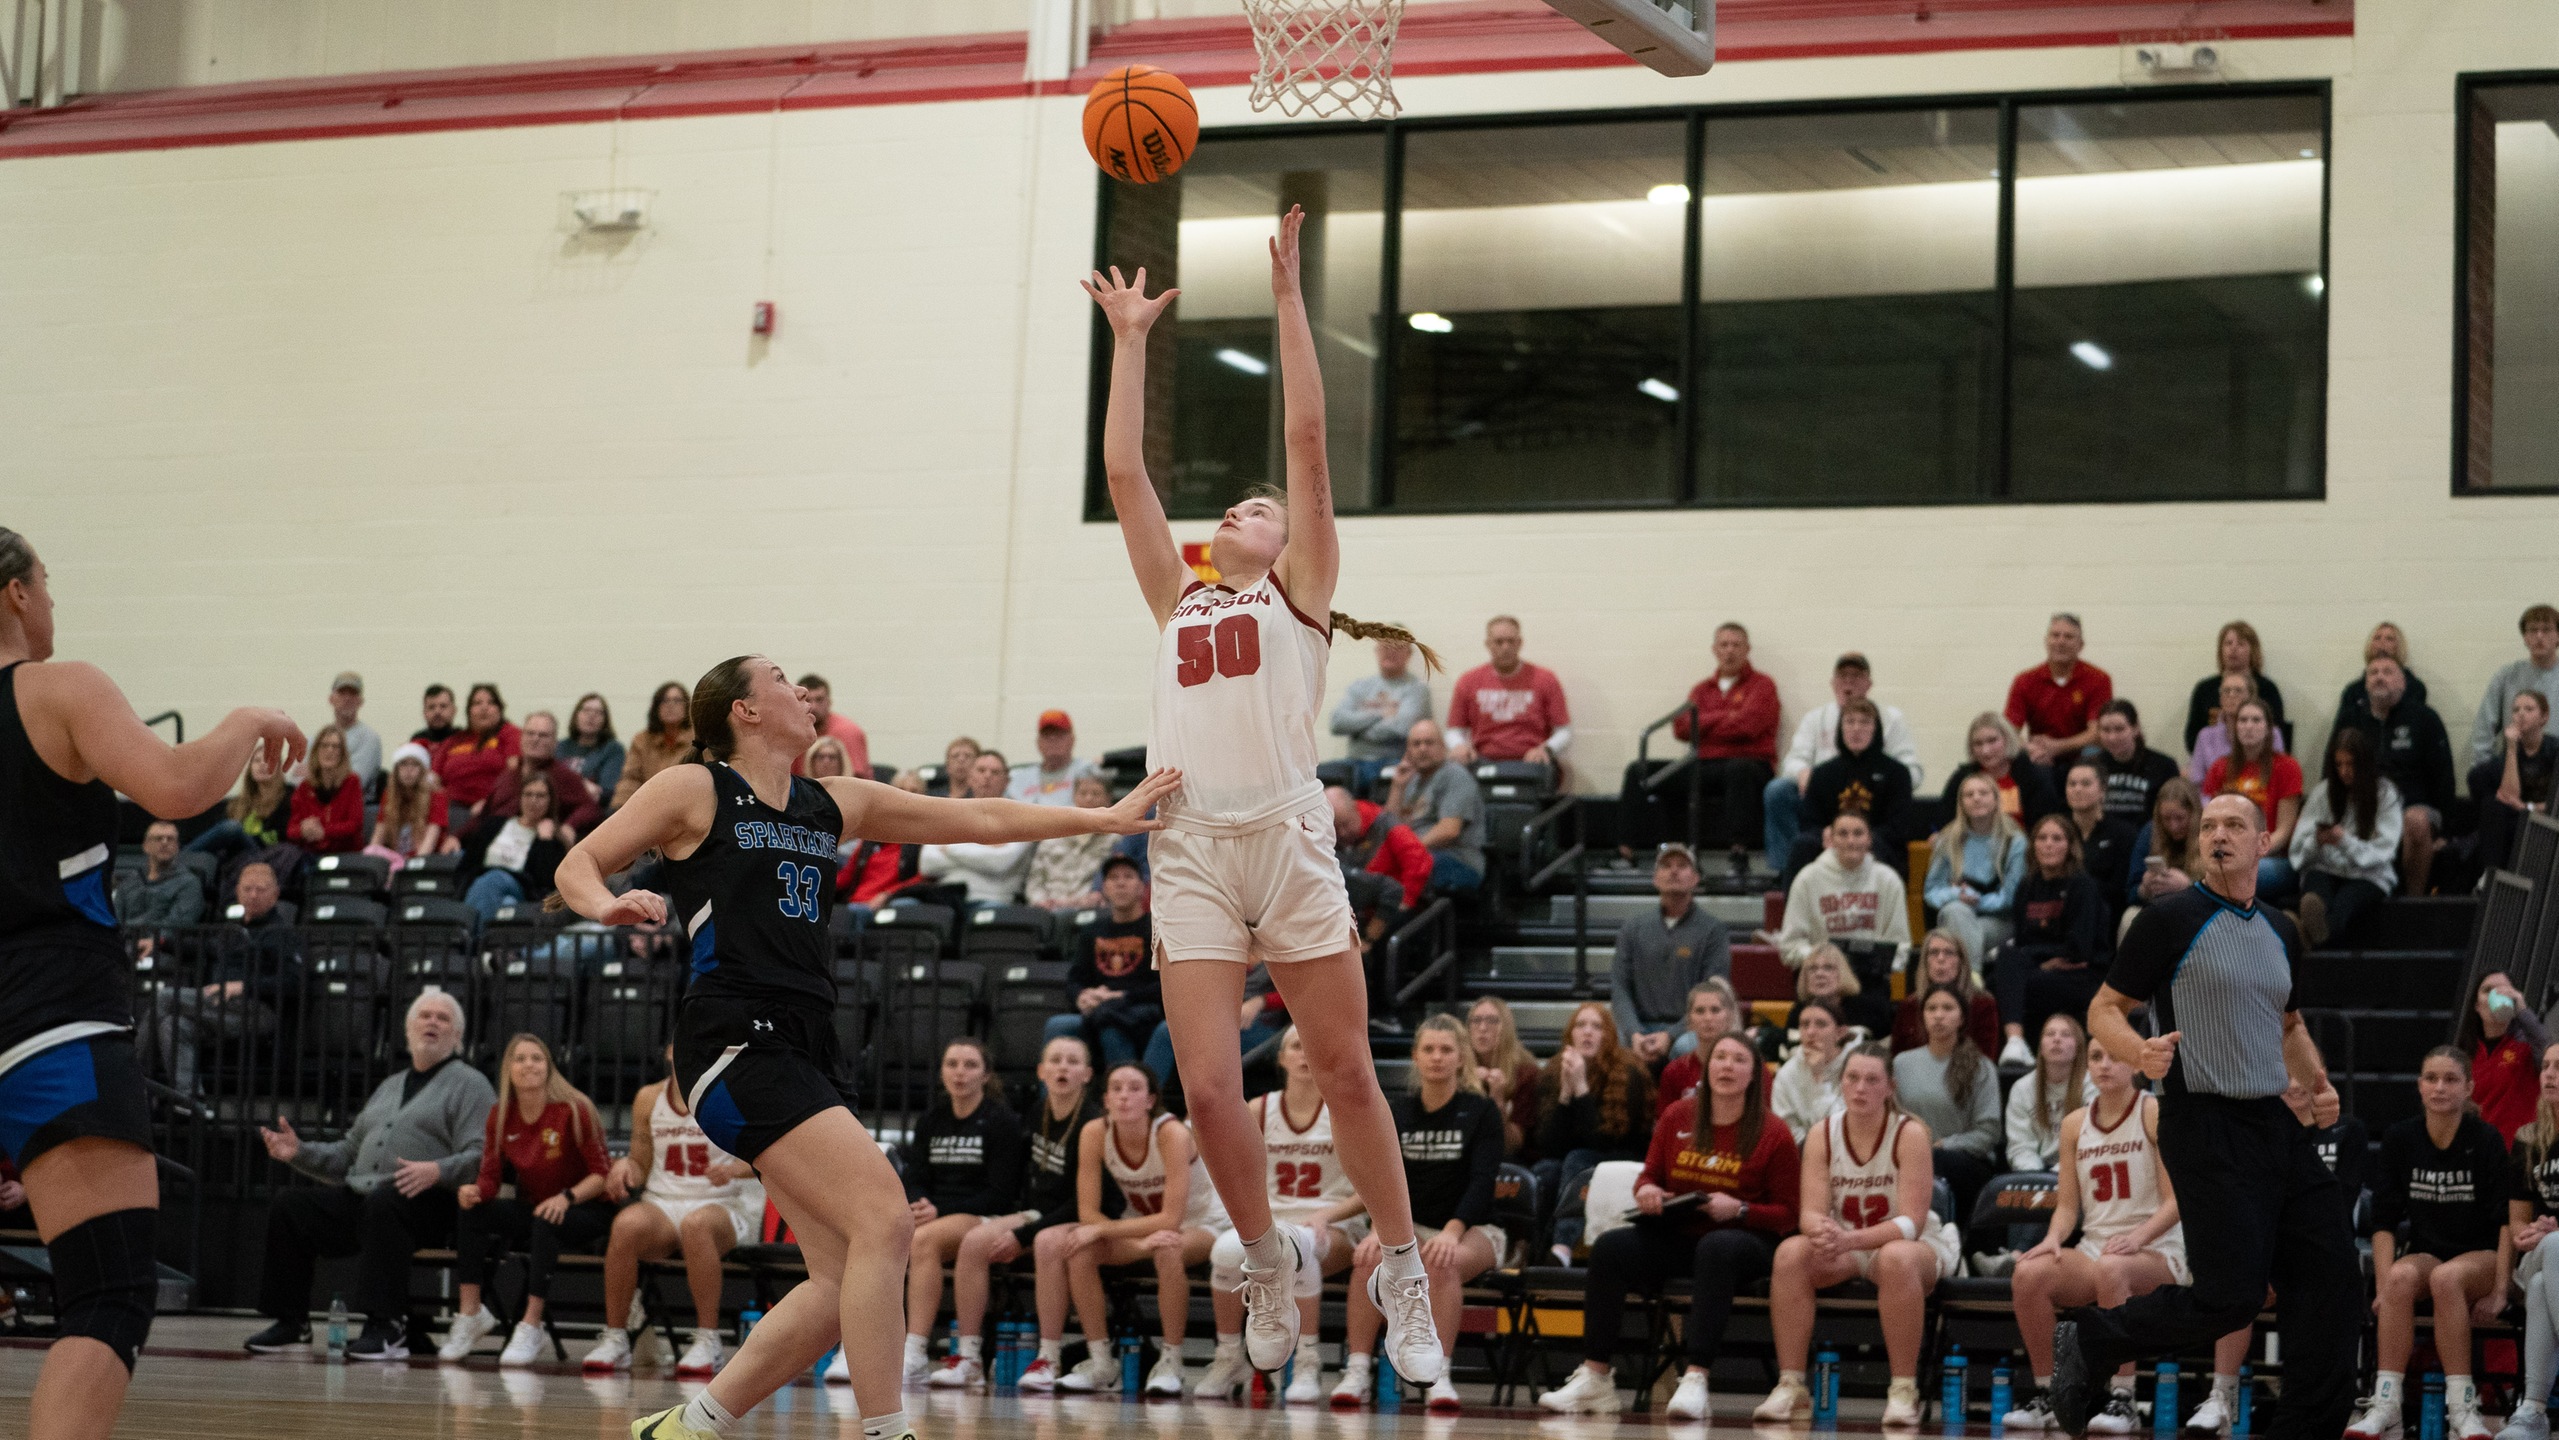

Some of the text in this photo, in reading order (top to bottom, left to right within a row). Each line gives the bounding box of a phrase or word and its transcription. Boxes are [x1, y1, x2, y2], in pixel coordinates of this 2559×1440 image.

[1177, 613, 1261, 688] 50
[734, 821, 838, 862] SPARTANS
[777, 861, 822, 923] 33
[655, 1127, 704, 1138] SIMPSO
[2078, 1140, 2144, 1161] SIMPSON
[664, 1143, 710, 1177] 45
[1275, 1161, 1322, 1198] 22
[2090, 1160, 2131, 1202] 31
[1841, 1193, 1890, 1229] 42
